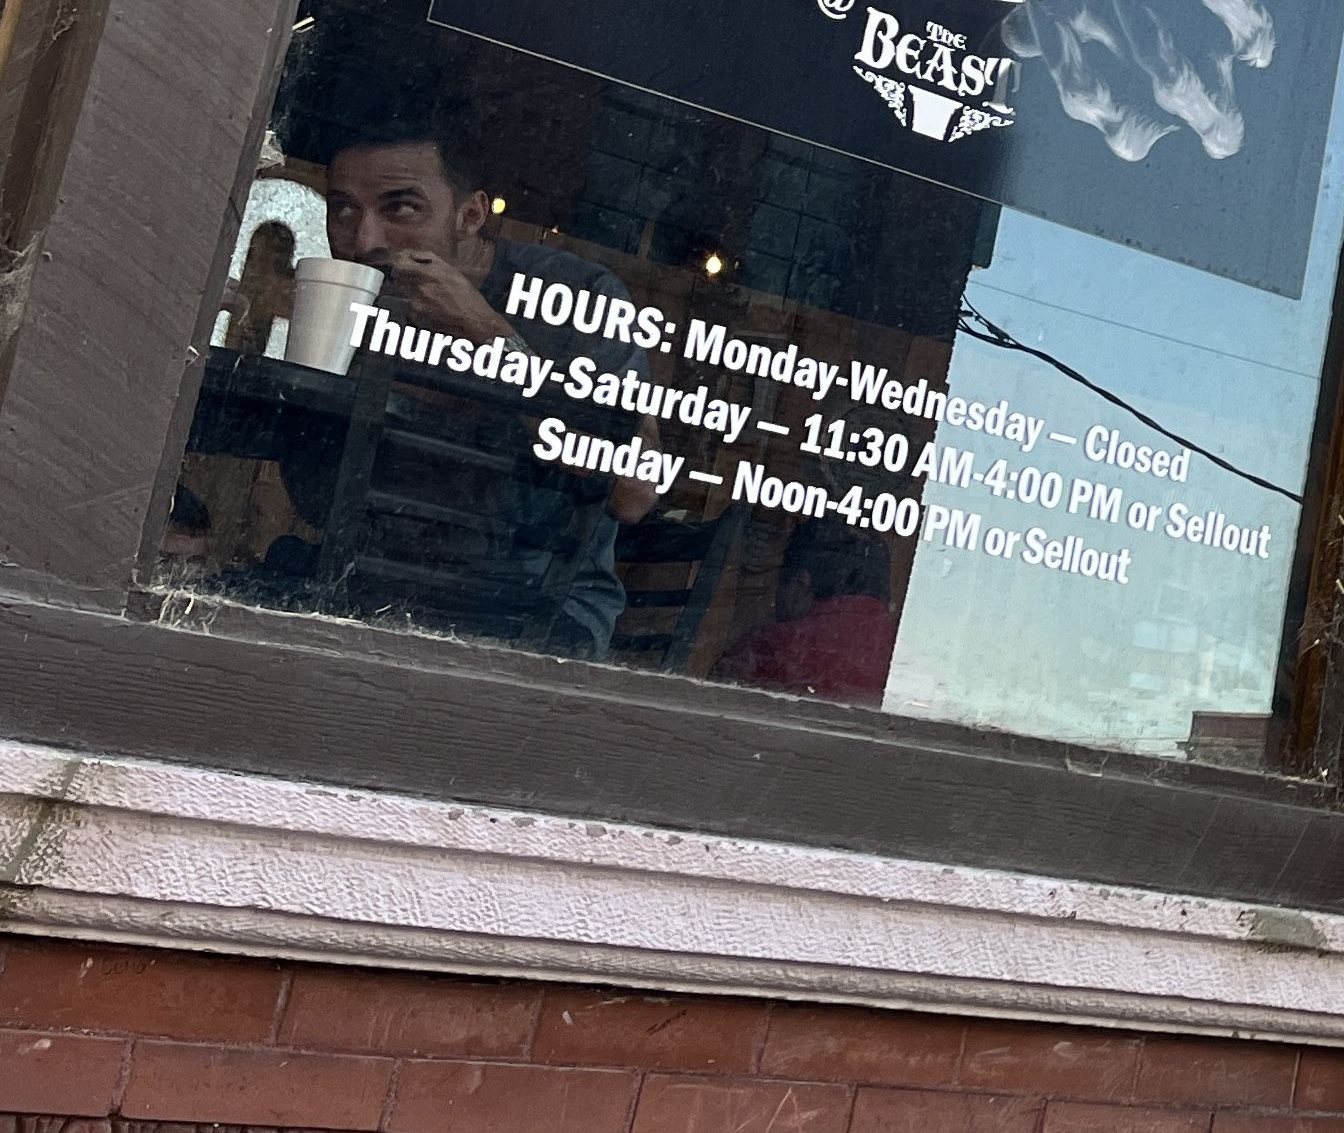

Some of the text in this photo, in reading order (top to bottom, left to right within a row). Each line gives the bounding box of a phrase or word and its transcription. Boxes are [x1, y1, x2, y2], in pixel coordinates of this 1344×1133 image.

[348, 302, 752, 444] Thursday-Saturday
[800, 413, 909, 474] 11:30
[912, 442, 1063, 509] AM-4:00
[1069, 479, 1124, 523] PM
[1127, 499, 1163, 532] or
[1164, 502, 1272, 559] Sellout
[505, 271, 676, 354] HOURS:
[684, 319, 1046, 453] Monday-Wednesday
[1084, 424, 1192, 483] Closed
[533, 416, 685, 495] Sunday
[732, 460, 919, 538] Noon-4:00
[923, 505, 981, 552] PM
[984, 525, 1023, 559] or
[1021, 526, 1132, 585] Sellout
